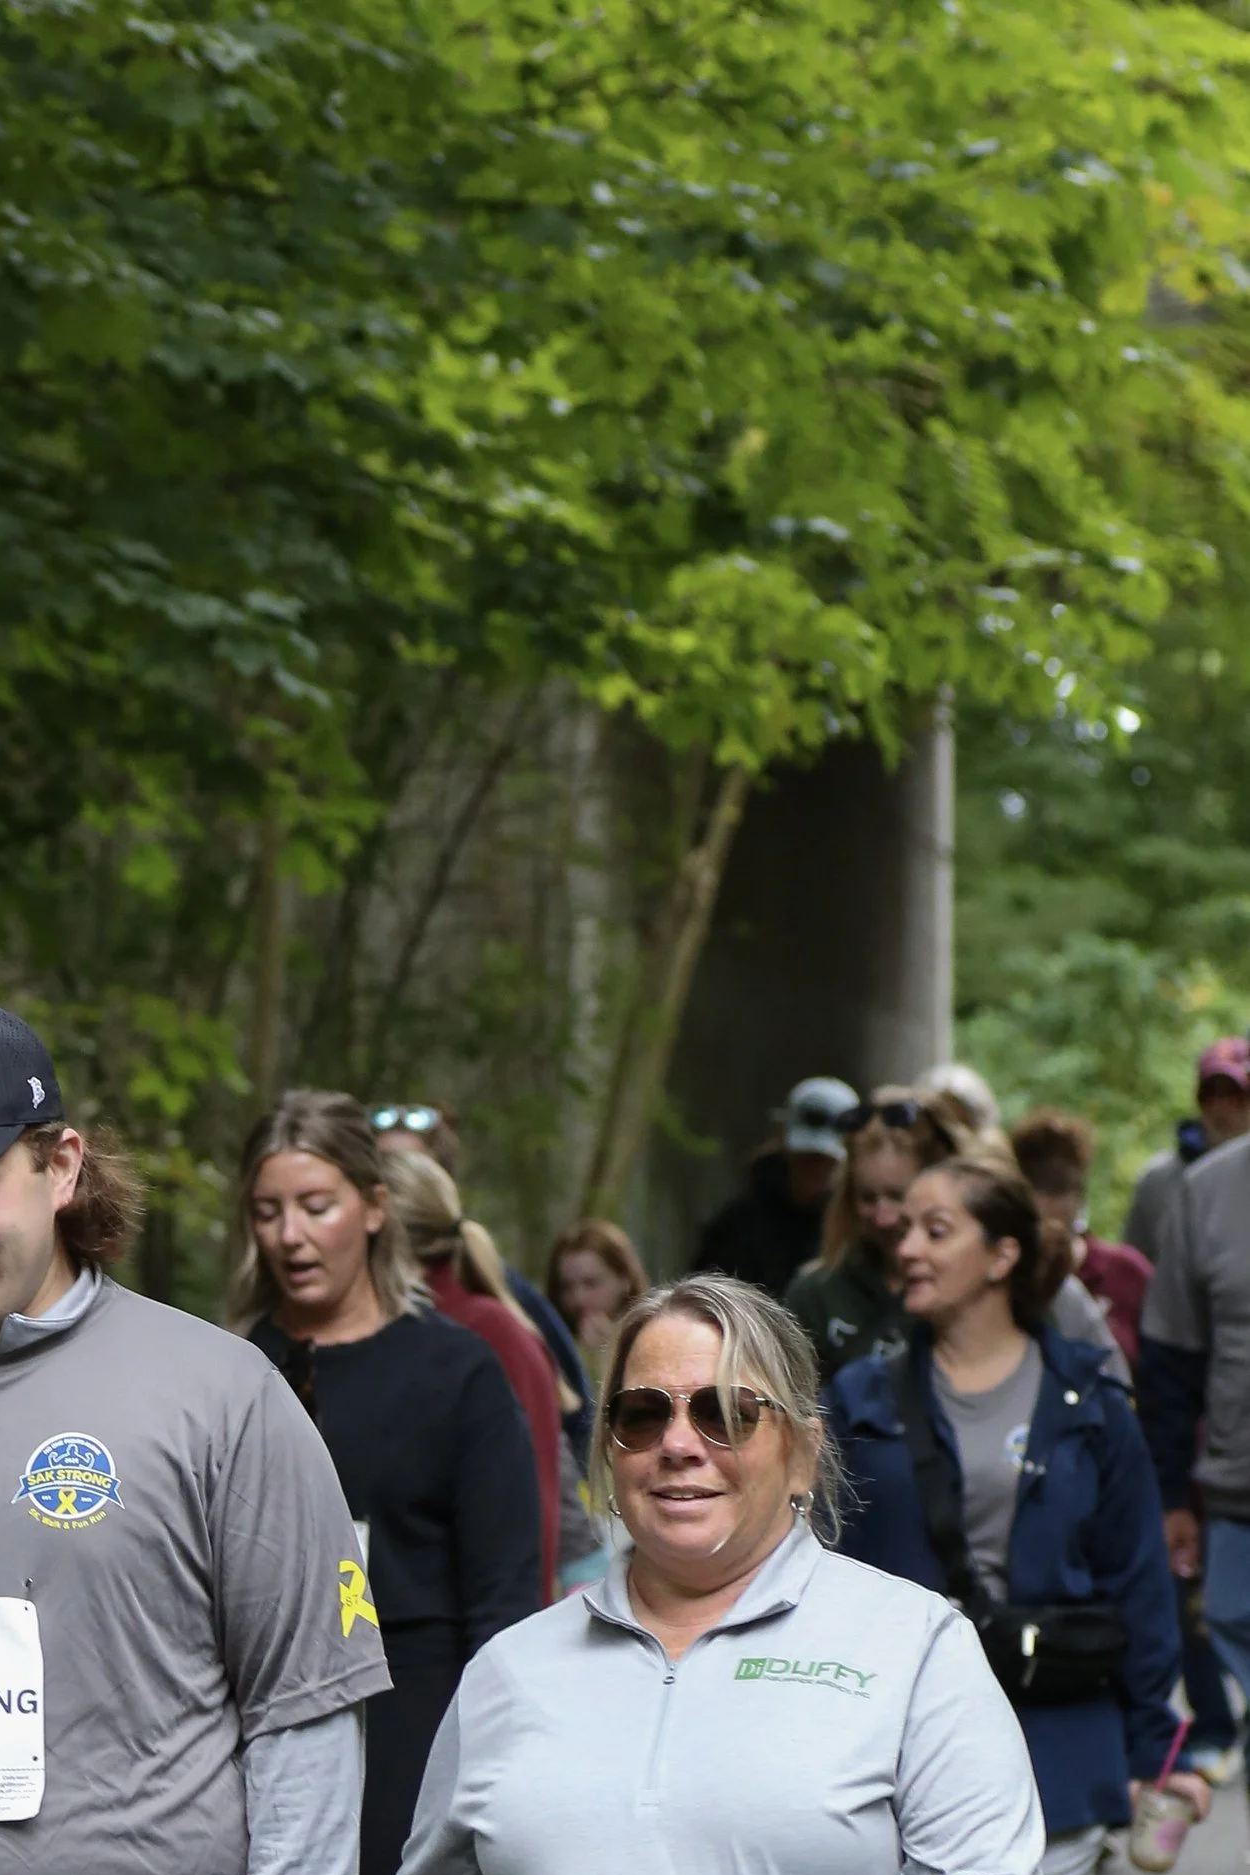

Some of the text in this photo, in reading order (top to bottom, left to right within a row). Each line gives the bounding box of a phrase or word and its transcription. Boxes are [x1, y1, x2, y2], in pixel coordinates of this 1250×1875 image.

[27, 1469, 113, 1489] SAK STRONG
[765, 1658, 878, 1688] DUFFY
